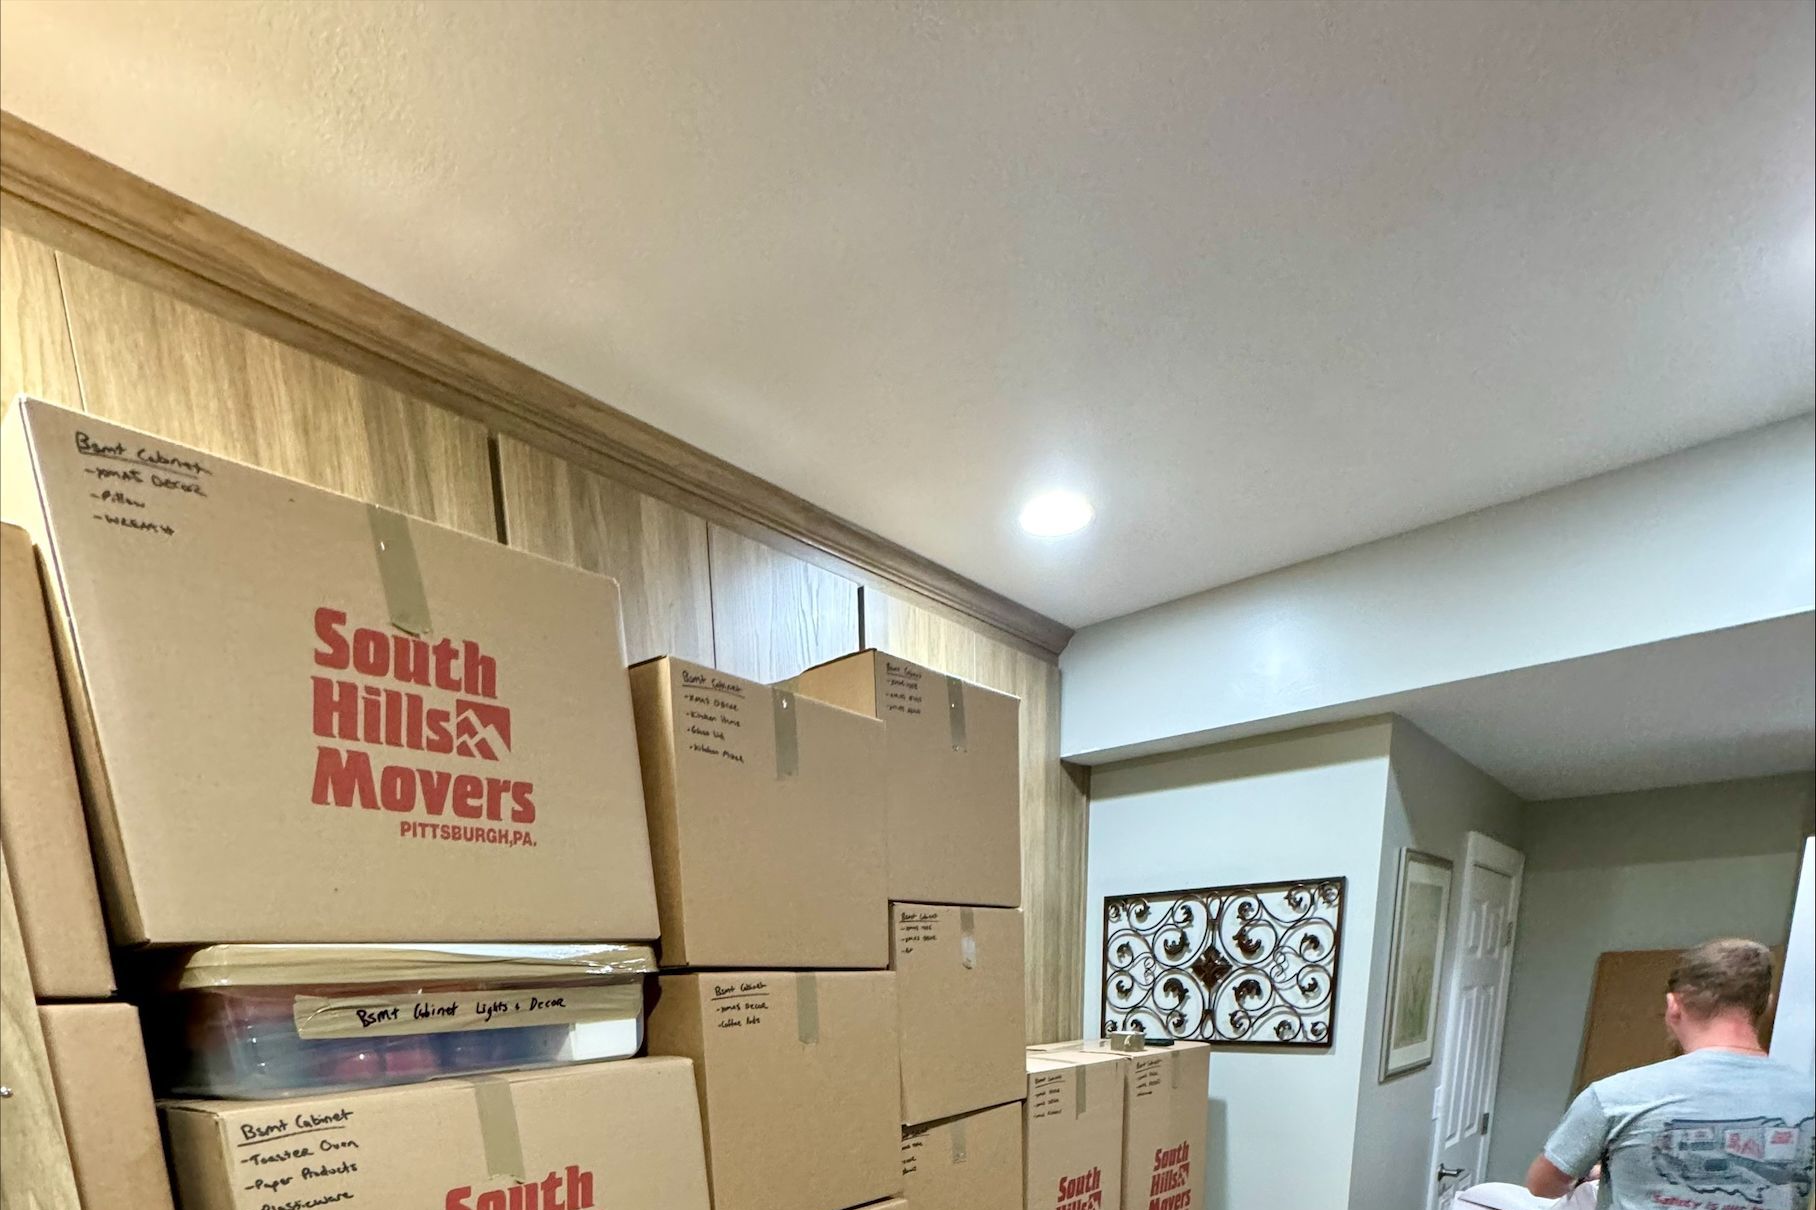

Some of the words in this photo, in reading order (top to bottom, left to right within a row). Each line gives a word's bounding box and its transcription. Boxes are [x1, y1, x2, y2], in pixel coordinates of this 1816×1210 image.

[314, 607, 497, 699] South
[310, 676, 454, 754] Hills
[311, 746, 536, 823] Movers
[356, 1007, 400, 1028] Bsmt
[476, 1001, 508, 1022] Lights
[240, 1120, 288, 1140] Bsmt
[295, 1108, 354, 1128] Cabinet
[301, 1161, 358, 1180] Products
[1153, 1140, 1190, 1172] South
[1057, 1166, 1101, 1203] South
[1150, 1169, 1178, 1197] Hills
